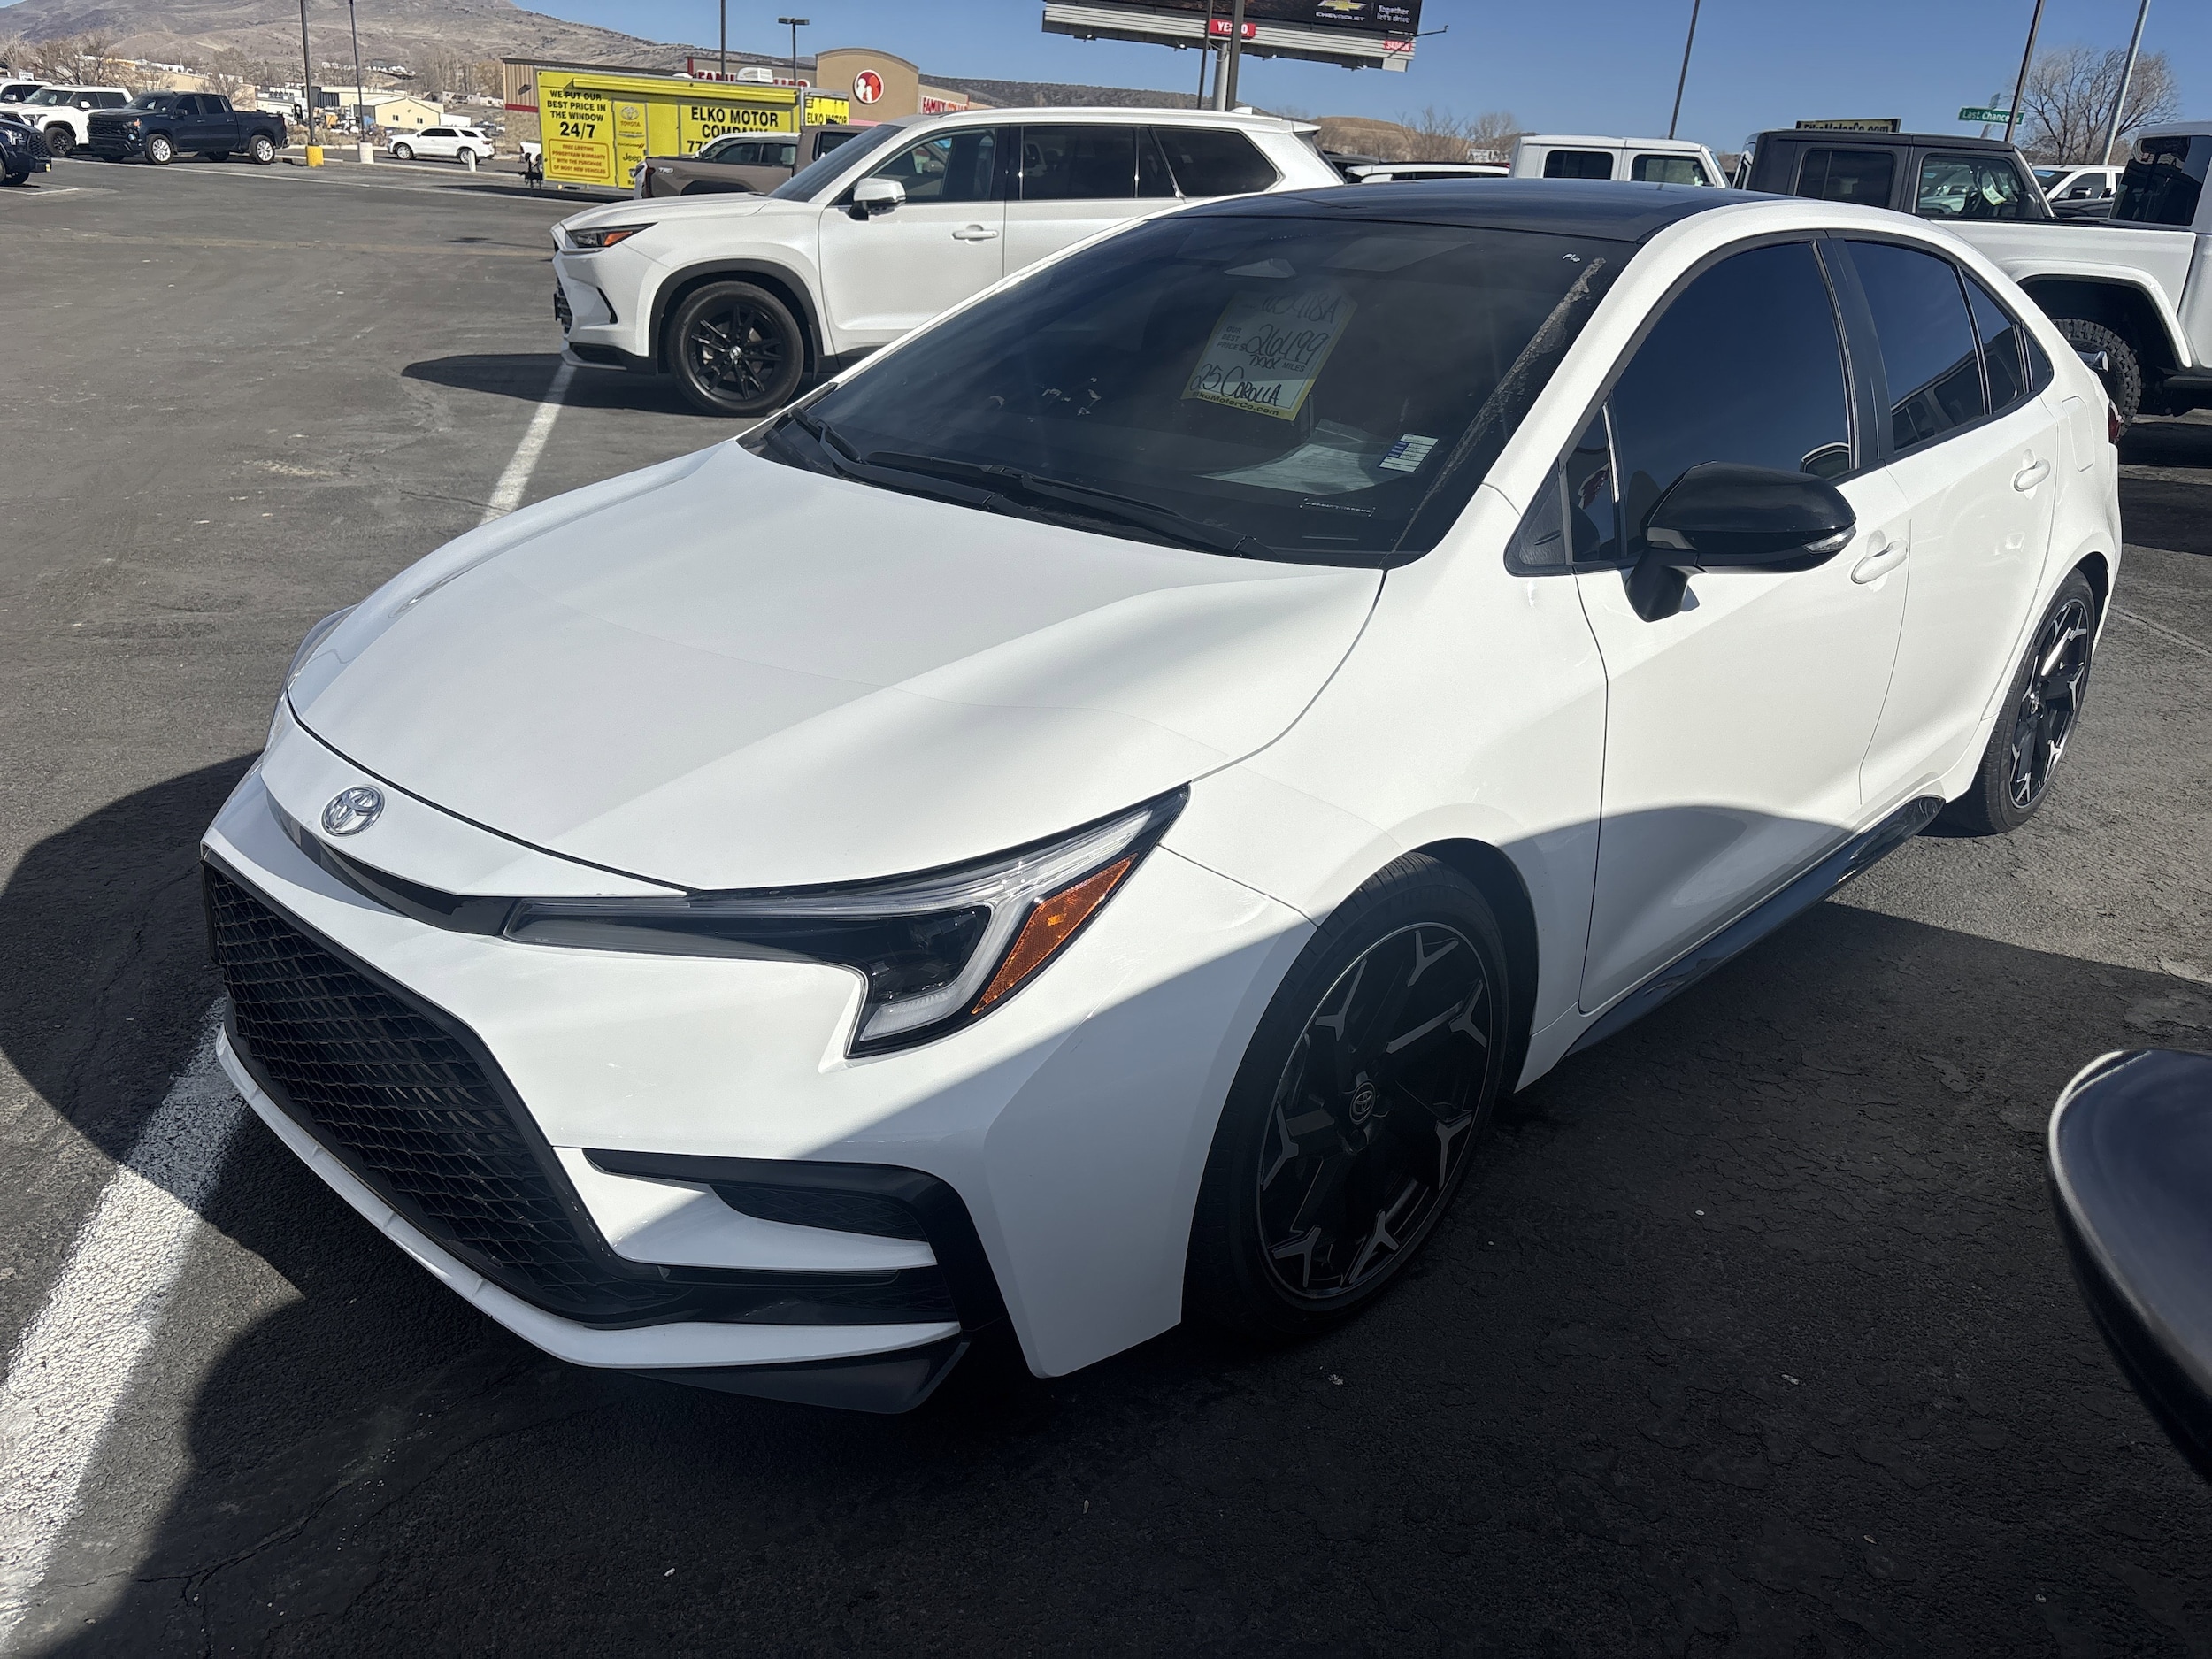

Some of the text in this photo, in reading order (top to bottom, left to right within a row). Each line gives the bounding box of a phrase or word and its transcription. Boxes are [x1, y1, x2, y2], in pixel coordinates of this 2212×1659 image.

[1379, 5, 1410, 15] Together
[1316, 12, 1365, 21] CHEVROLET
[547, 100, 568, 109] BEST
[570, 102, 595, 111] PRICE
[569, 112, 603, 121] WINDOW
[691, 106, 778, 127] ELKO MOTOR
[807, 112, 823, 124] ELKO
[1962, 111, 1980, 119] Last
[1982, 111, 2010, 122] Chance
[560, 121, 595, 140] 24/7
[622, 153, 642, 163] Jeep
[1217, 342, 1238, 350] PRICE
[1282, 362, 1306, 372] MILES
[1190, 364, 1223, 391] 25
